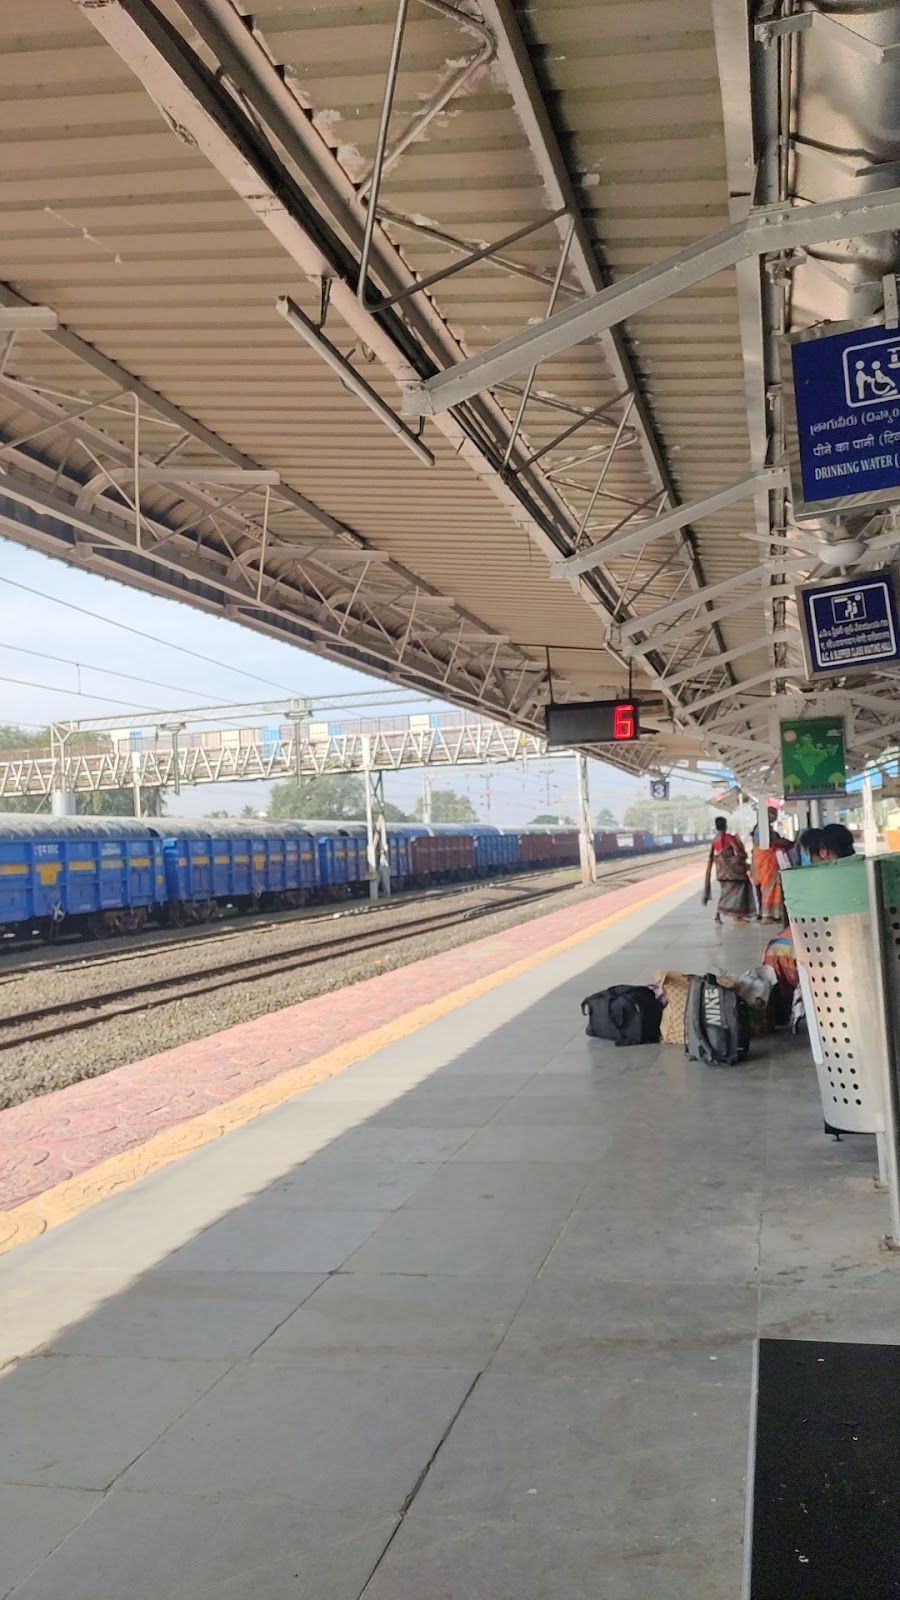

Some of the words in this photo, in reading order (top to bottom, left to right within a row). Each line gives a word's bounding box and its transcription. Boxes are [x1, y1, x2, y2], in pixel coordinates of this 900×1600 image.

[813, 441, 832, 457] पीने
[835, 441, 850, 453] का
[852, 433, 875, 449] पानी
[815, 461, 860, 480] DRINKING
[860, 455, 893, 471] WATER
[614, 705, 635, 739] 6
[653, 783, 665, 798] 3
[705, 988, 721, 1026] NIKE
